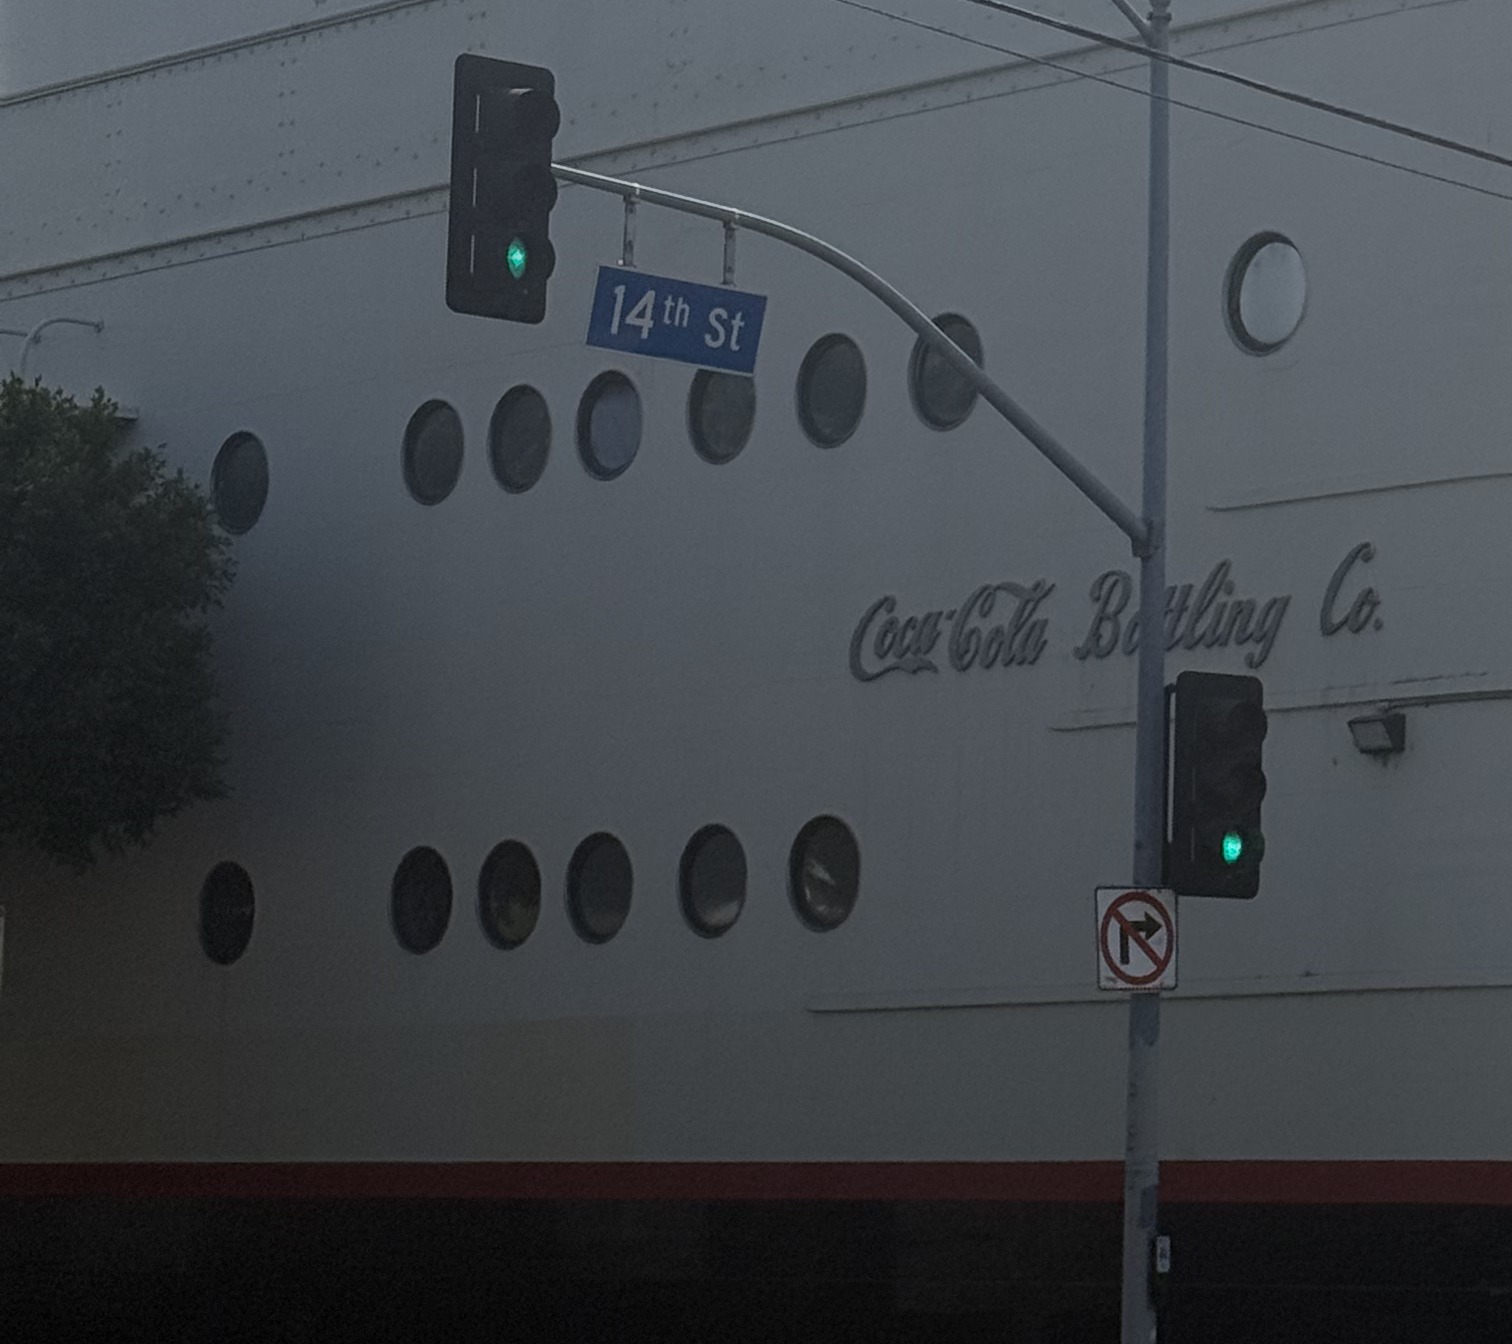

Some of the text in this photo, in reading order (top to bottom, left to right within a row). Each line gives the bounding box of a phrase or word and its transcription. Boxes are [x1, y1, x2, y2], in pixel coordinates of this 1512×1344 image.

[610, 284, 746, 352] 14th St
[848, 578, 1056, 683] Coca-Cola
[1319, 541, 1384, 638] Co.
